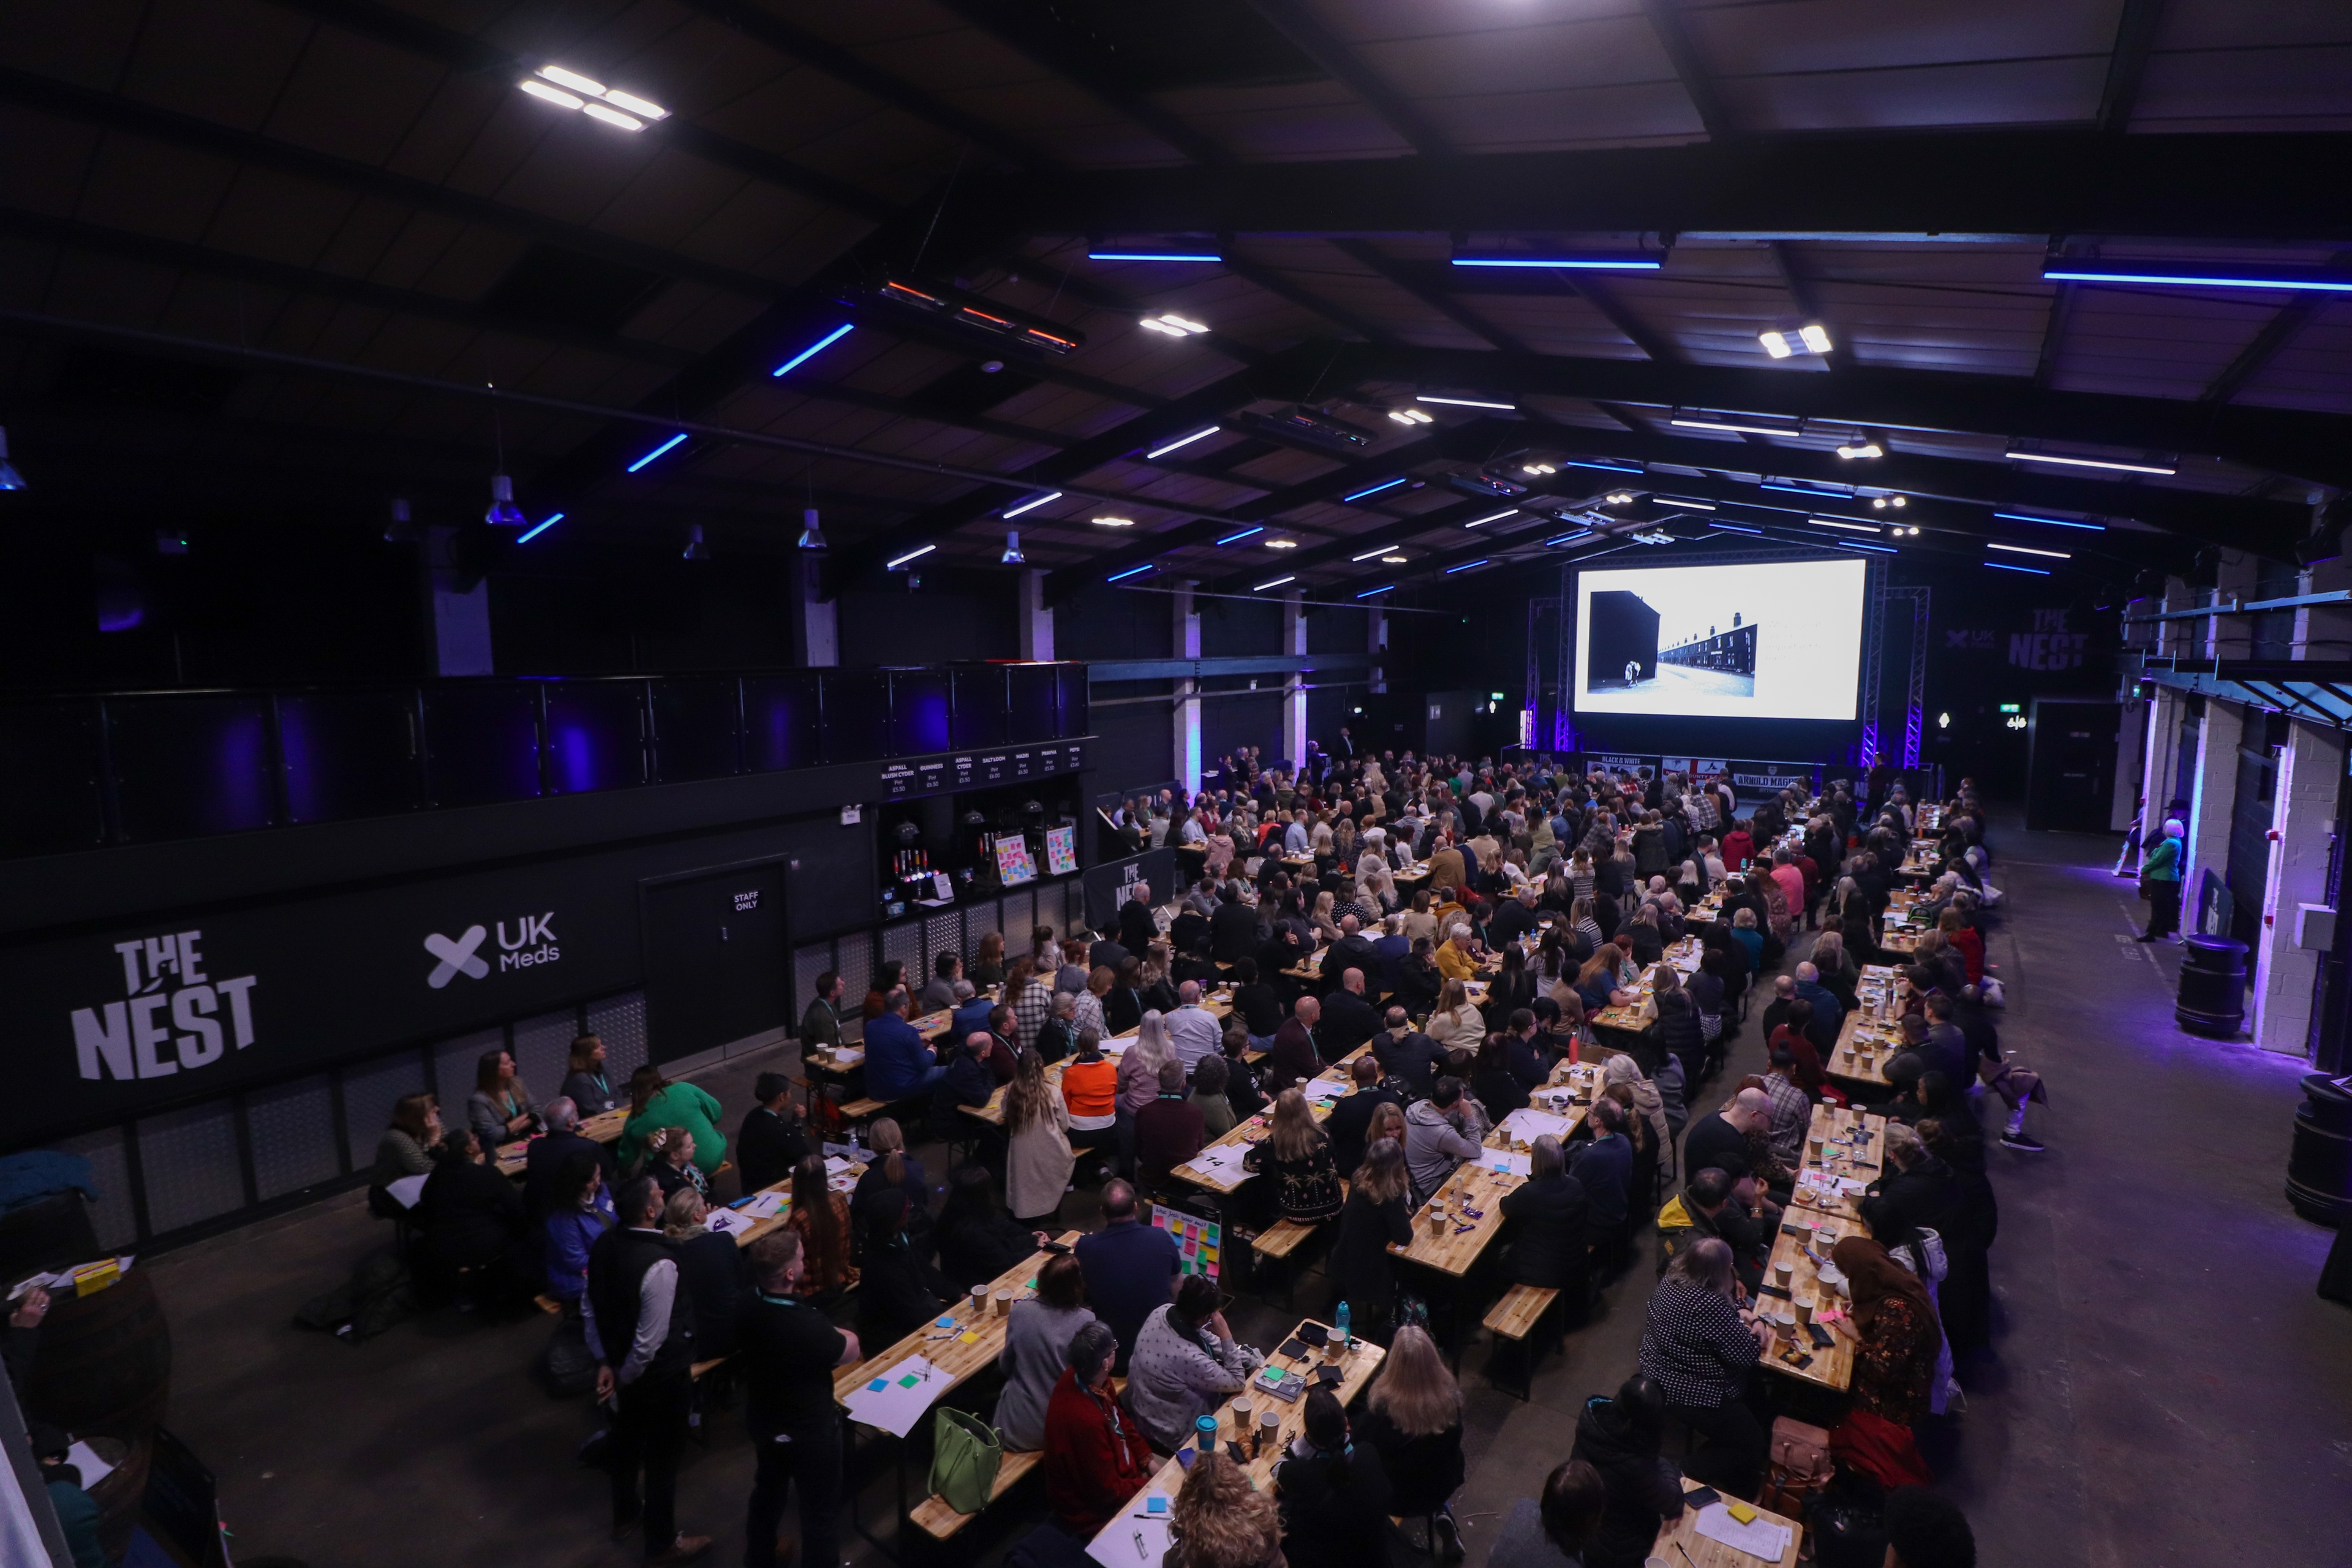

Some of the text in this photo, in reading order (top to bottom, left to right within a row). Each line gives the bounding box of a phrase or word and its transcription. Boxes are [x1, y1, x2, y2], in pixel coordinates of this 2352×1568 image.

[2032, 608, 2070, 633] THE
[1972, 630, 1995, 641] UK
[2008, 633, 2089, 671] NEST
[1738, 775, 1768, 786] ARNOLD
[1123, 863, 1140, 884] THE
[734, 891, 759, 903] STAFF
[736, 900, 758, 911] ONLY
[1116, 878, 1148, 911] NE
[497, 911, 557, 951] UK
[114, 930, 208, 997] THE
[500, 943, 560, 973] Meds
[70, 975, 257, 1080] NEST
[1205, 1156, 1226, 1167] 14
